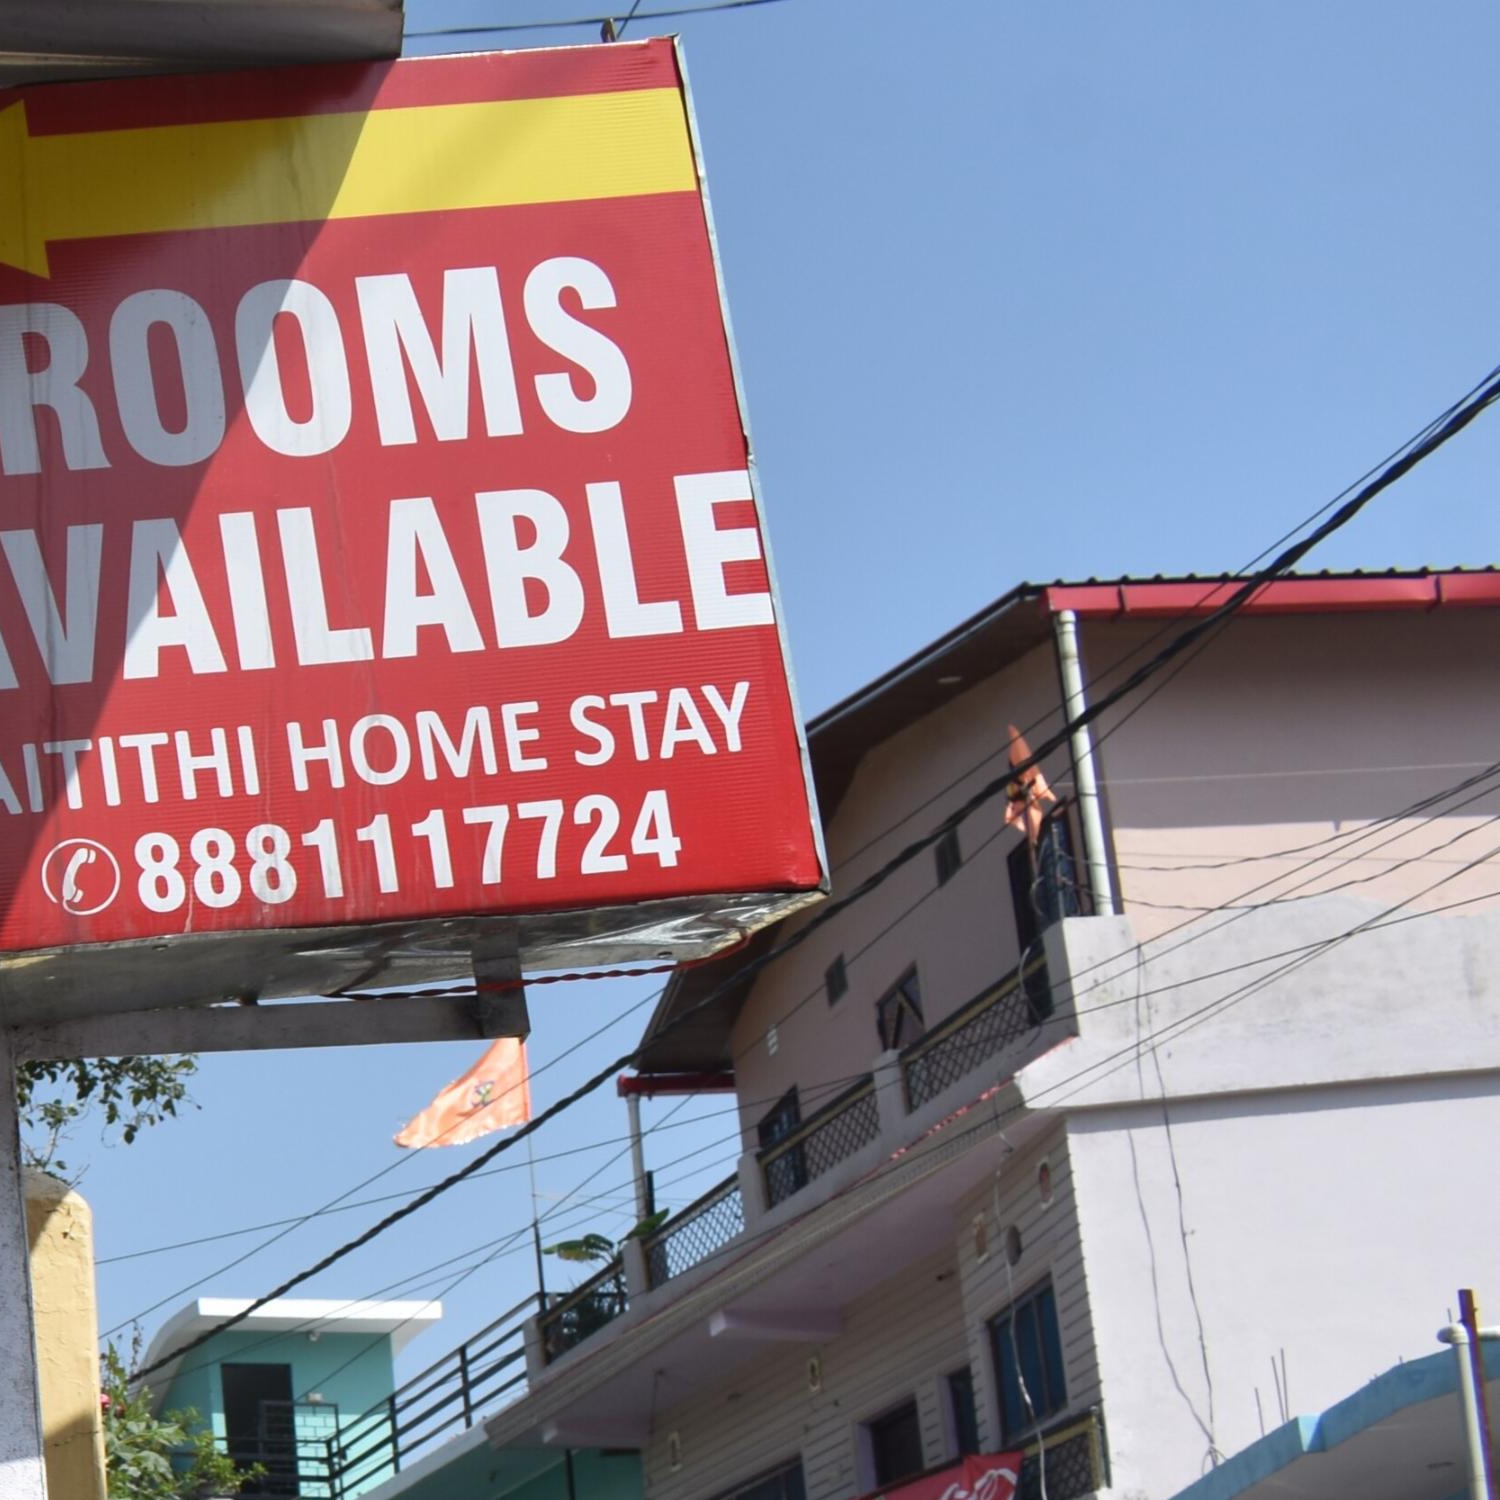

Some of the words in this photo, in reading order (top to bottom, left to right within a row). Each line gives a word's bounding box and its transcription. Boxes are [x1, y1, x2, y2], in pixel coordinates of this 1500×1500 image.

[287, 700, 548, 792] HOME
[569, 681, 751, 766] STAY
[133, 790, 681, 913] 8881117724
